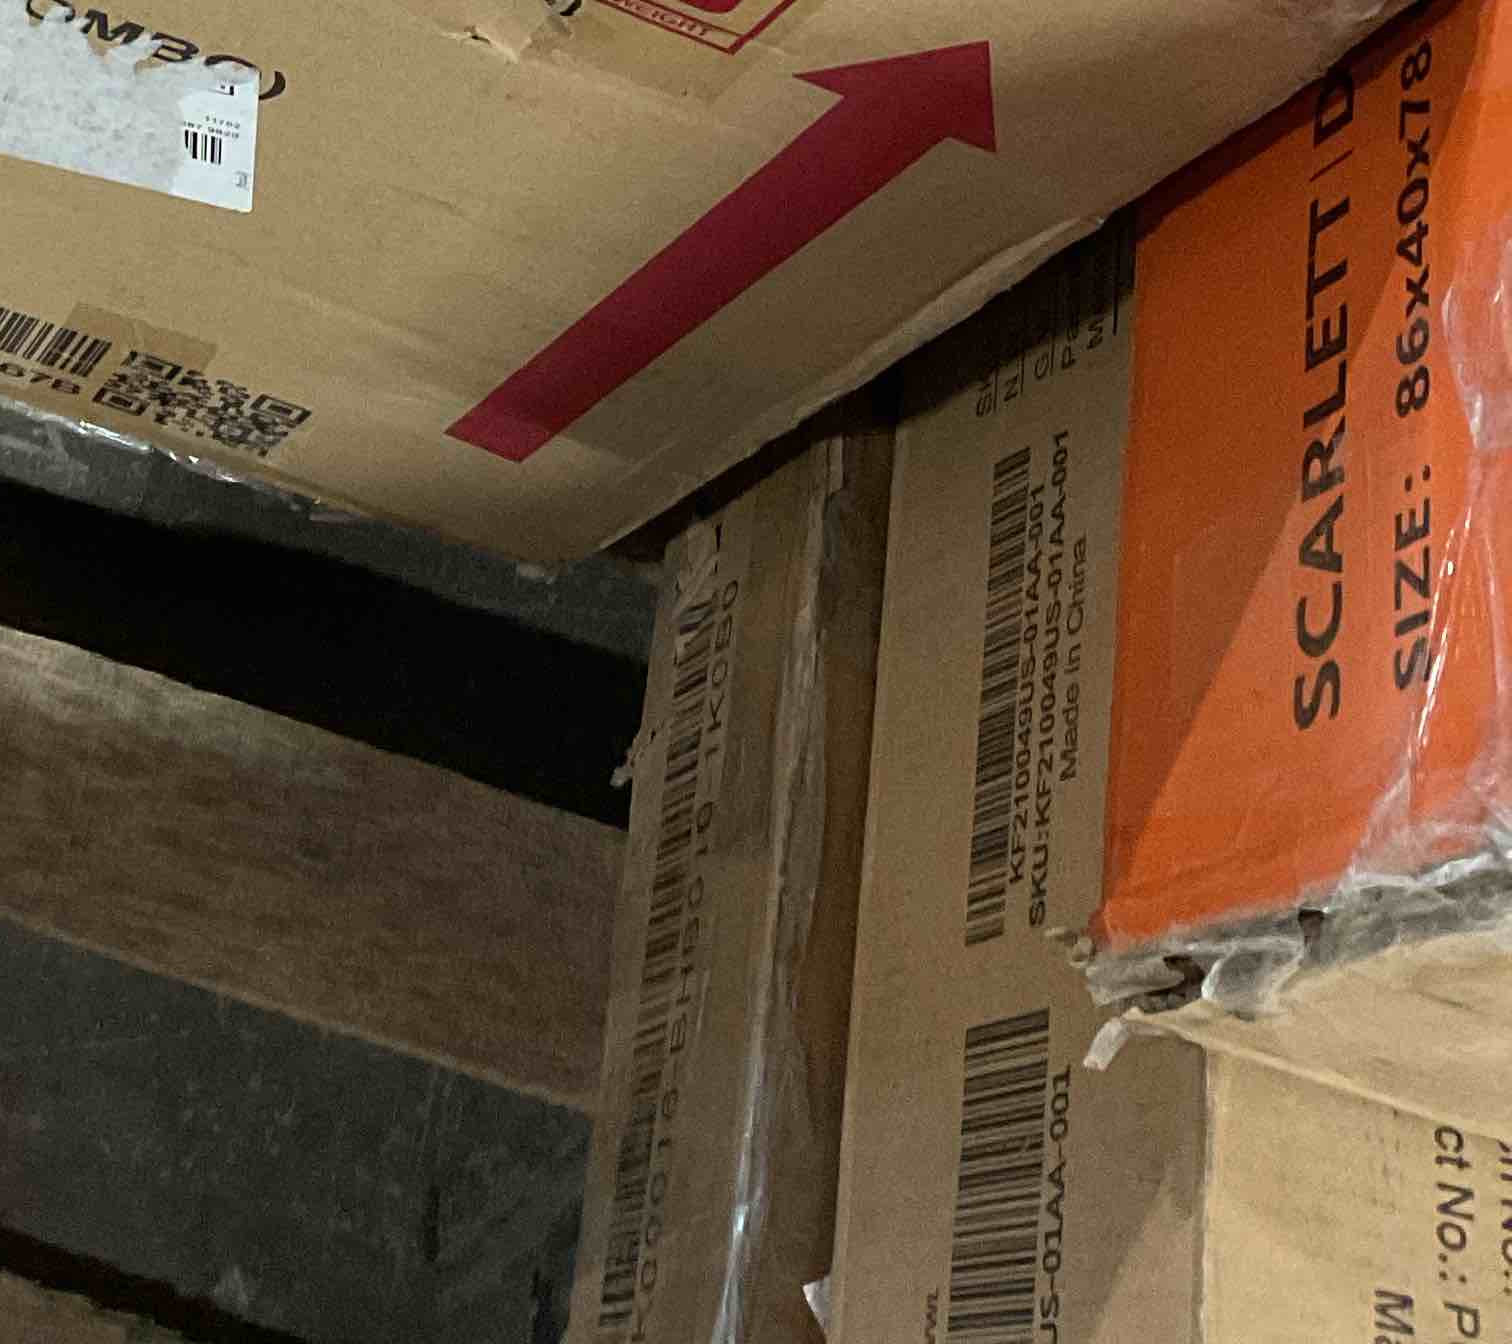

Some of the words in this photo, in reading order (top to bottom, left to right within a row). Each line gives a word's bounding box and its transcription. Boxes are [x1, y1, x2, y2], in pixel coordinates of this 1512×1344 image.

[1395, 37, 1436, 418] 86x40x78
[1292, 196, 1351, 733] SCARLETT
[1392, 462, 1434, 694] SIZE:
[1065, 534, 1088, 649] China
[1060, 695, 1084, 785] Made
